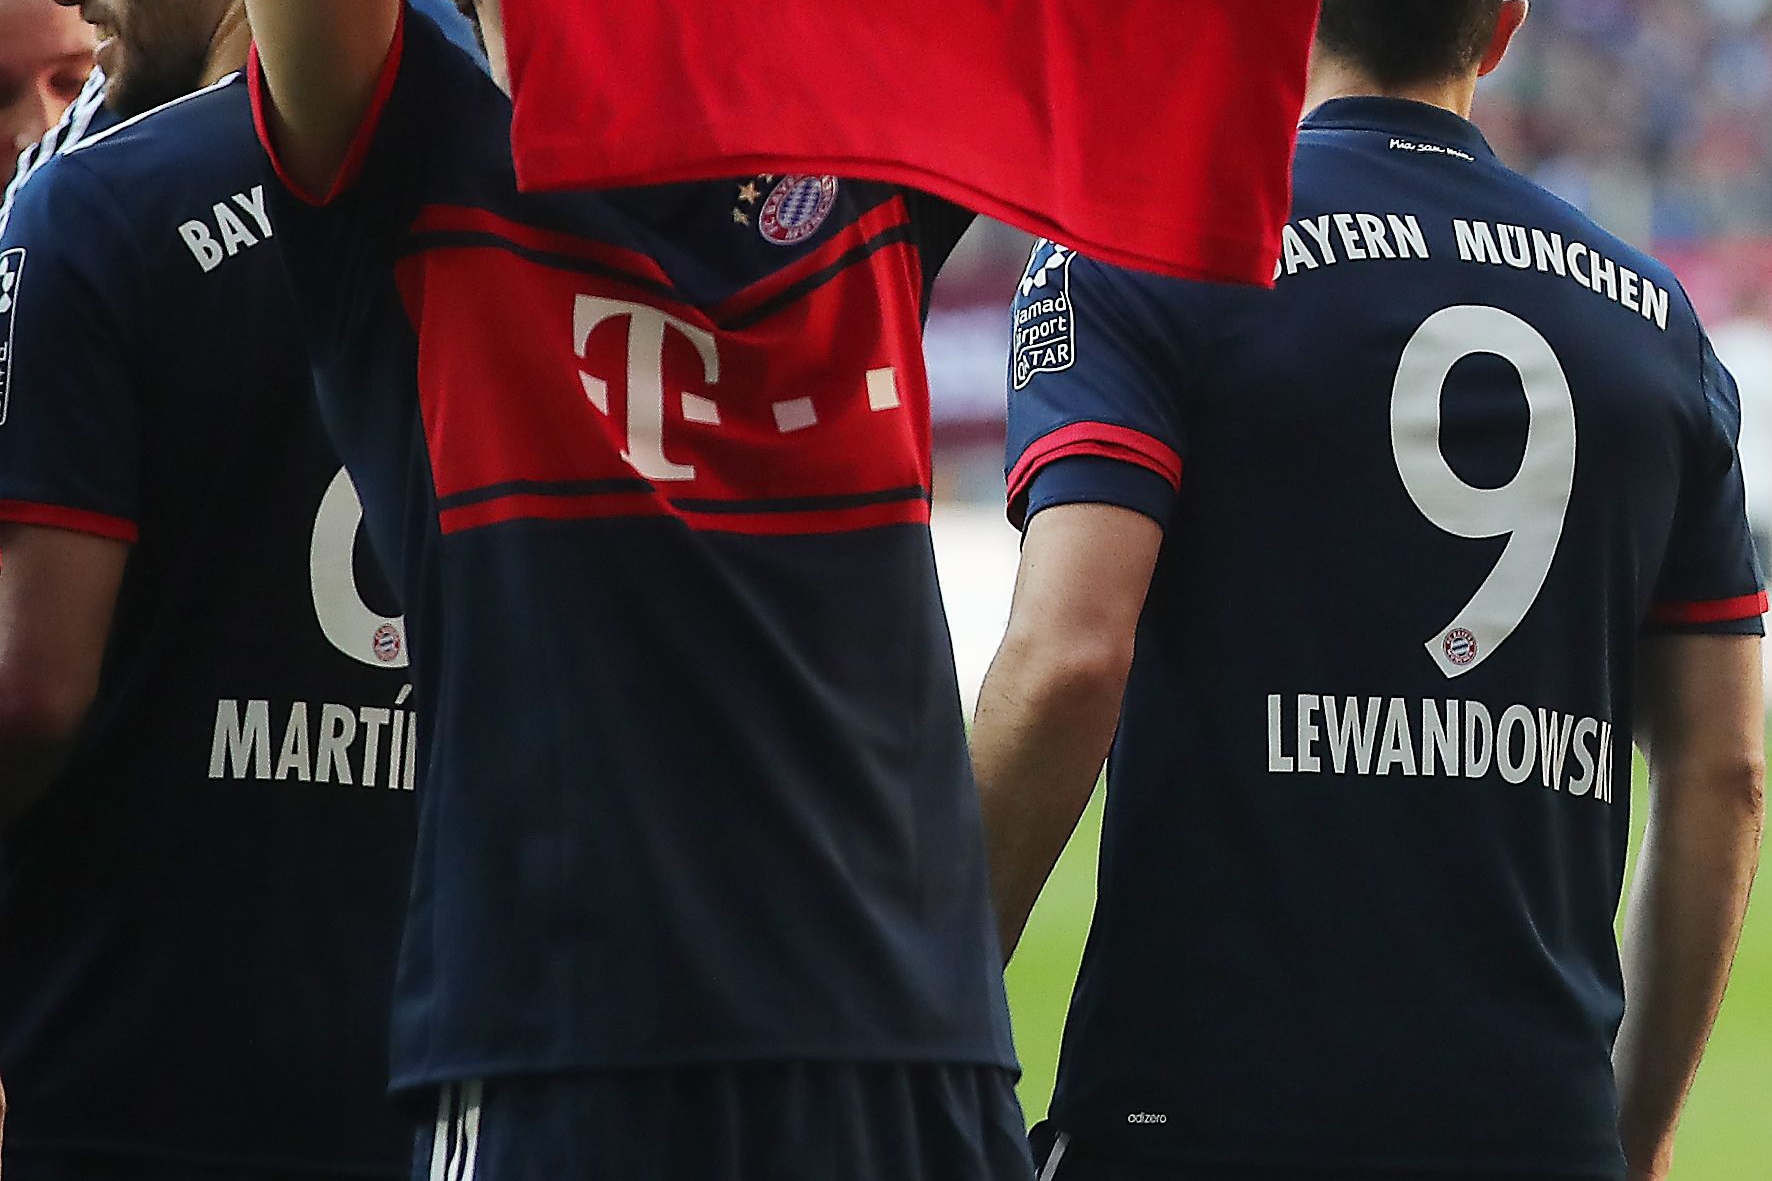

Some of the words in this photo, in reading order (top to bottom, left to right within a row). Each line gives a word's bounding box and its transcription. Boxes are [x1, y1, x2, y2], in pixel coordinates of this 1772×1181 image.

[1273, 213, 1430, 282] AYERN
[1452, 218, 1669, 331] MÜNCHEN
[1017, 343, 1069, 380] QATAR
[1390, 304, 1577, 679] 9
[1127, 1111, 1167, 1123] adizero
